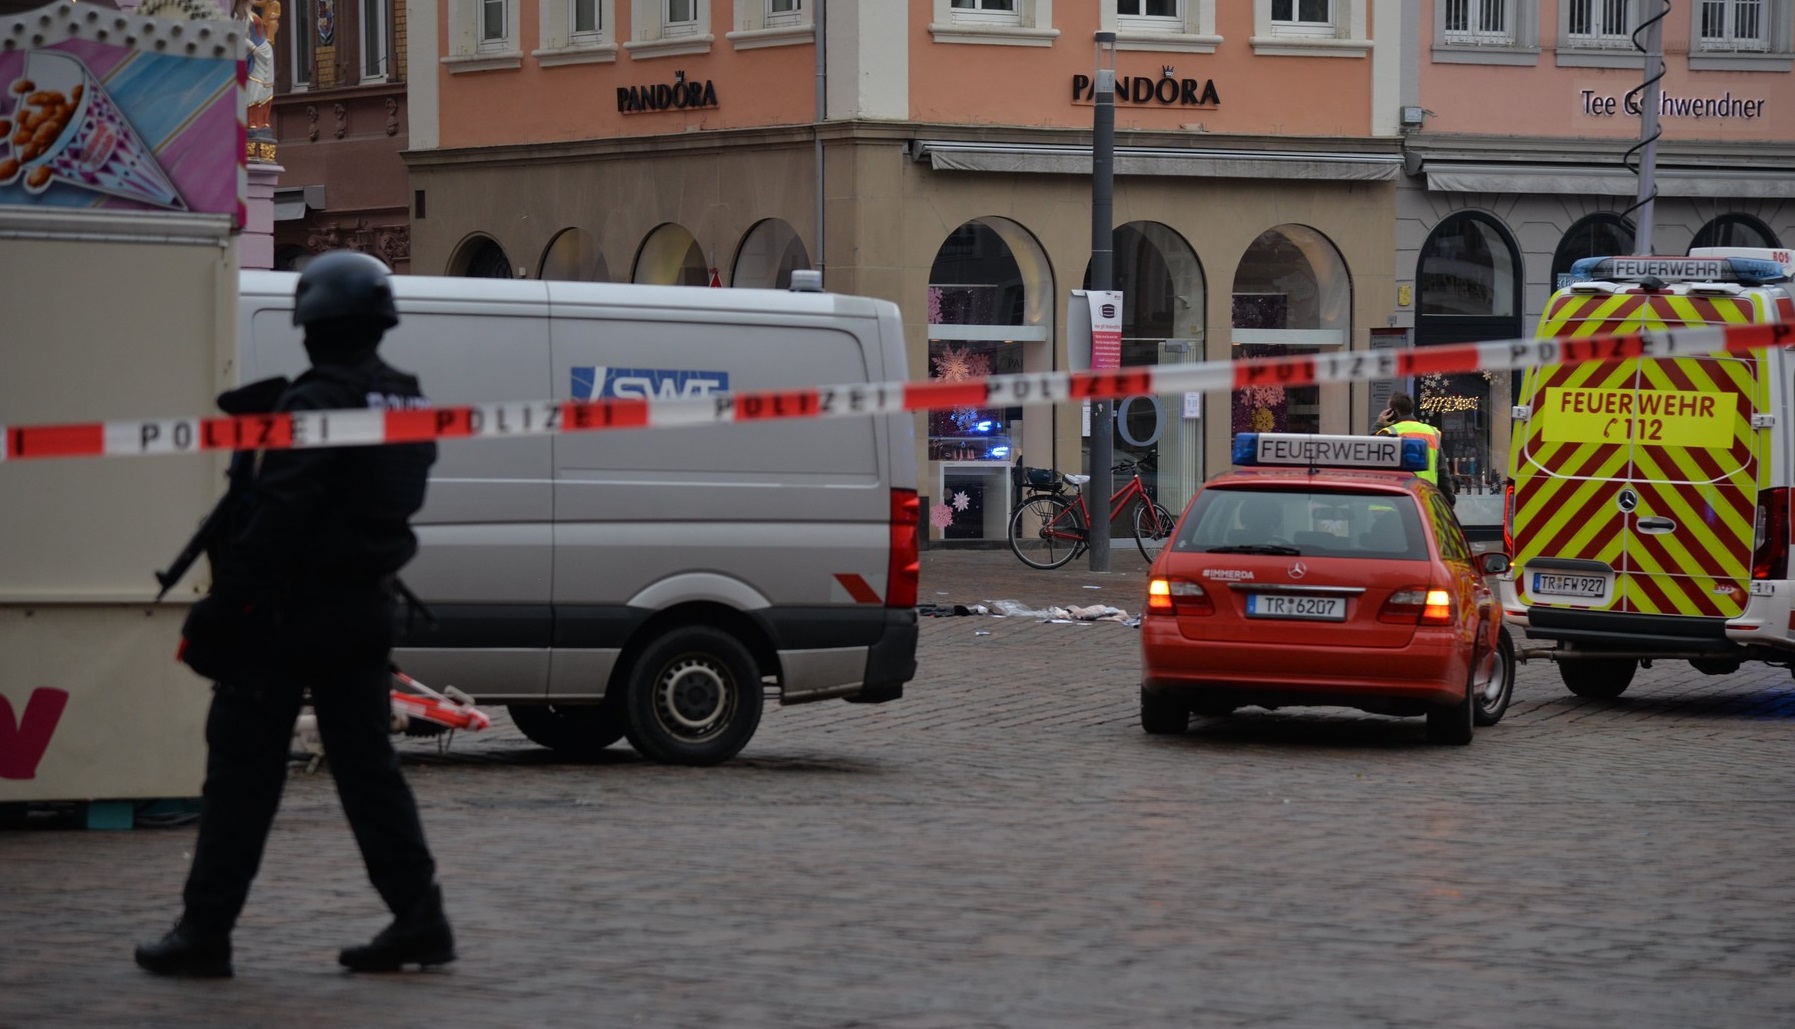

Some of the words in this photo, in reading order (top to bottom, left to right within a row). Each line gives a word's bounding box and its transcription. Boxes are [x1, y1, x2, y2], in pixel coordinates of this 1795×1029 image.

[617, 79, 718, 112] PANDORA
[1073, 74, 1221, 105] PNDORA
[1581, 90, 1616, 115] Tee
[1624, 91, 1765, 117] Ghwendner
[1615, 260, 1719, 278] FEUERWEHR
[1560, 391, 1716, 418] FEUERWEHR
[141, 415, 329, 450] POLIZEI
[435, 403, 613, 433] POLIZEI
[715, 388, 887, 418] POLIZEI
[1623, 418, 1664, 441] 112
[1260, 440, 1396, 462] FEUERWEHR
[1541, 576, 1556, 590] TR
[1563, 577, 1579, 591] FW
[1581, 578, 1603, 592] 927
[1264, 597, 1285, 613] TR
[1295, 598, 1336, 616] 6207
